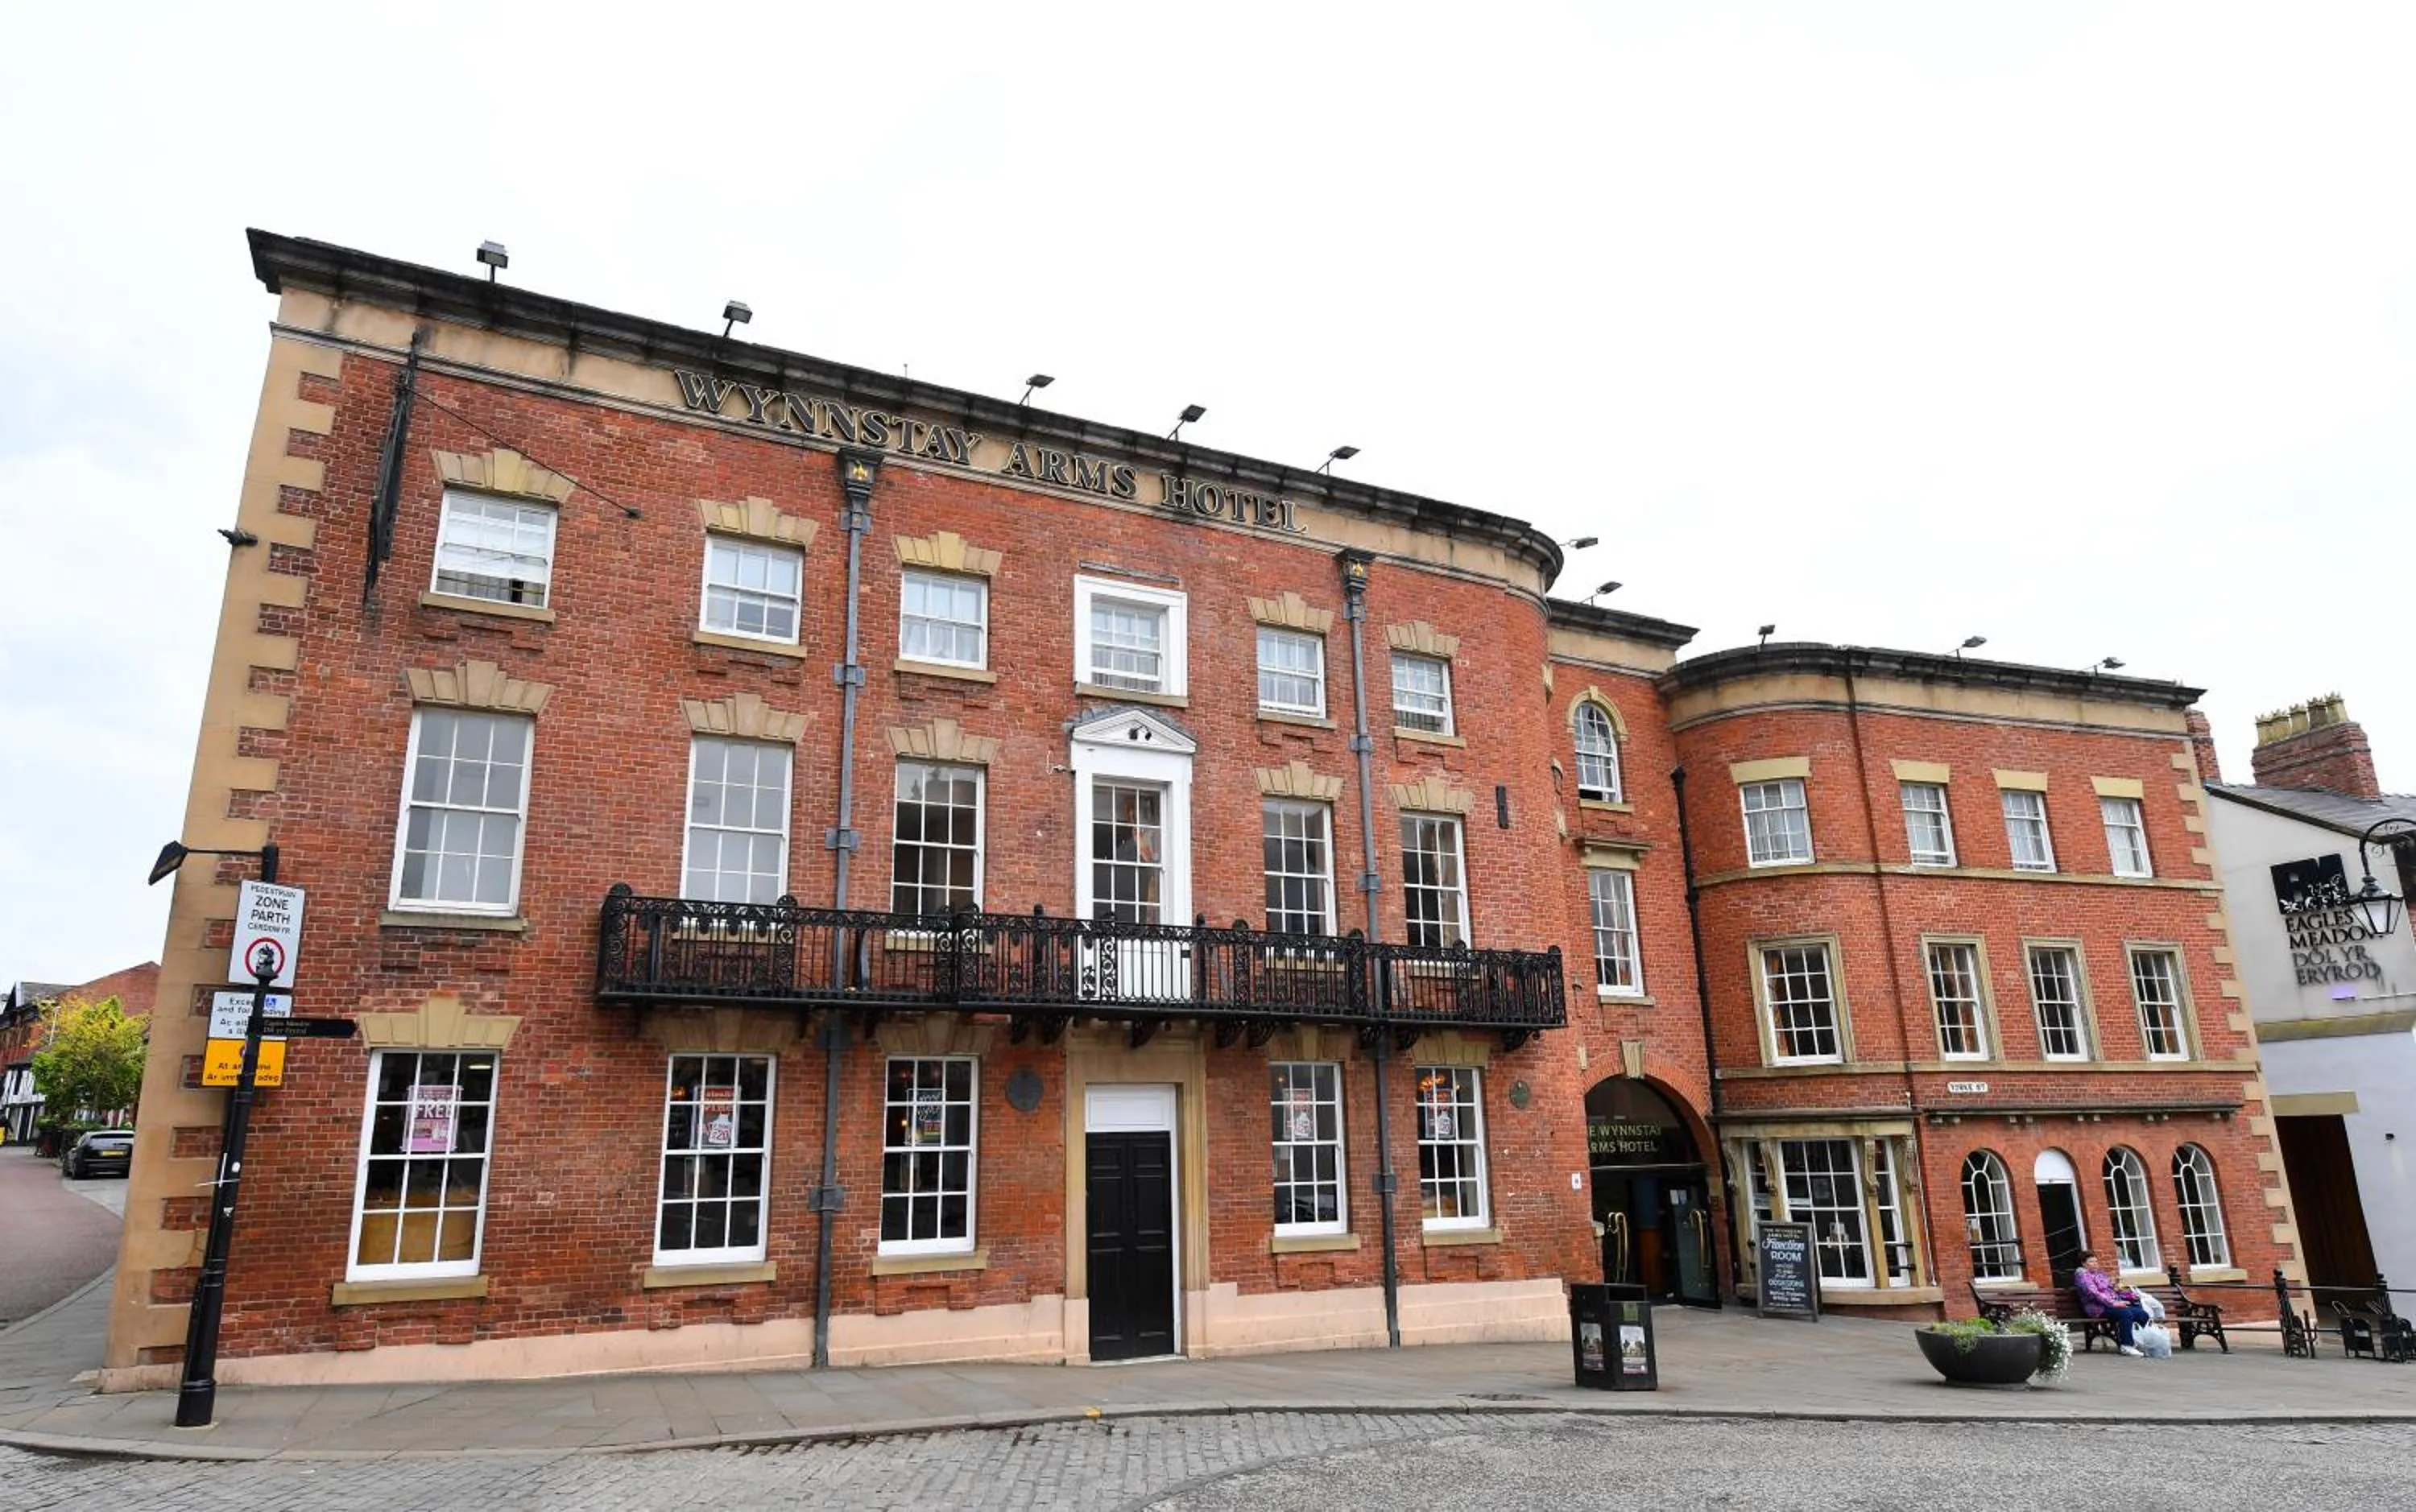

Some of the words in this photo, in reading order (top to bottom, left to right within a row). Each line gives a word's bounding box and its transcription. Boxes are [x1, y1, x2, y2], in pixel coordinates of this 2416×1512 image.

[674, 369, 983, 465] WYNNSTAY
[1002, 442, 1138, 499] ARMS
[1161, 471, 1308, 535] HOTEL
[255, 894, 289, 911] ZONE
[250, 909, 291, 925] PARTH
[2286, 909, 2354, 932] EAGLES
[2290, 925, 2366, 949] MEADO
[2340, 944, 2371, 962] YR
[2296, 962, 2381, 985] ERYROD
[230, 997, 254, 1006] Exce
[1590, 1141, 1616, 1154] RMS
[1618, 1140, 1658, 1153] HOTEL
[1770, 1250, 1802, 1262] ROOM
